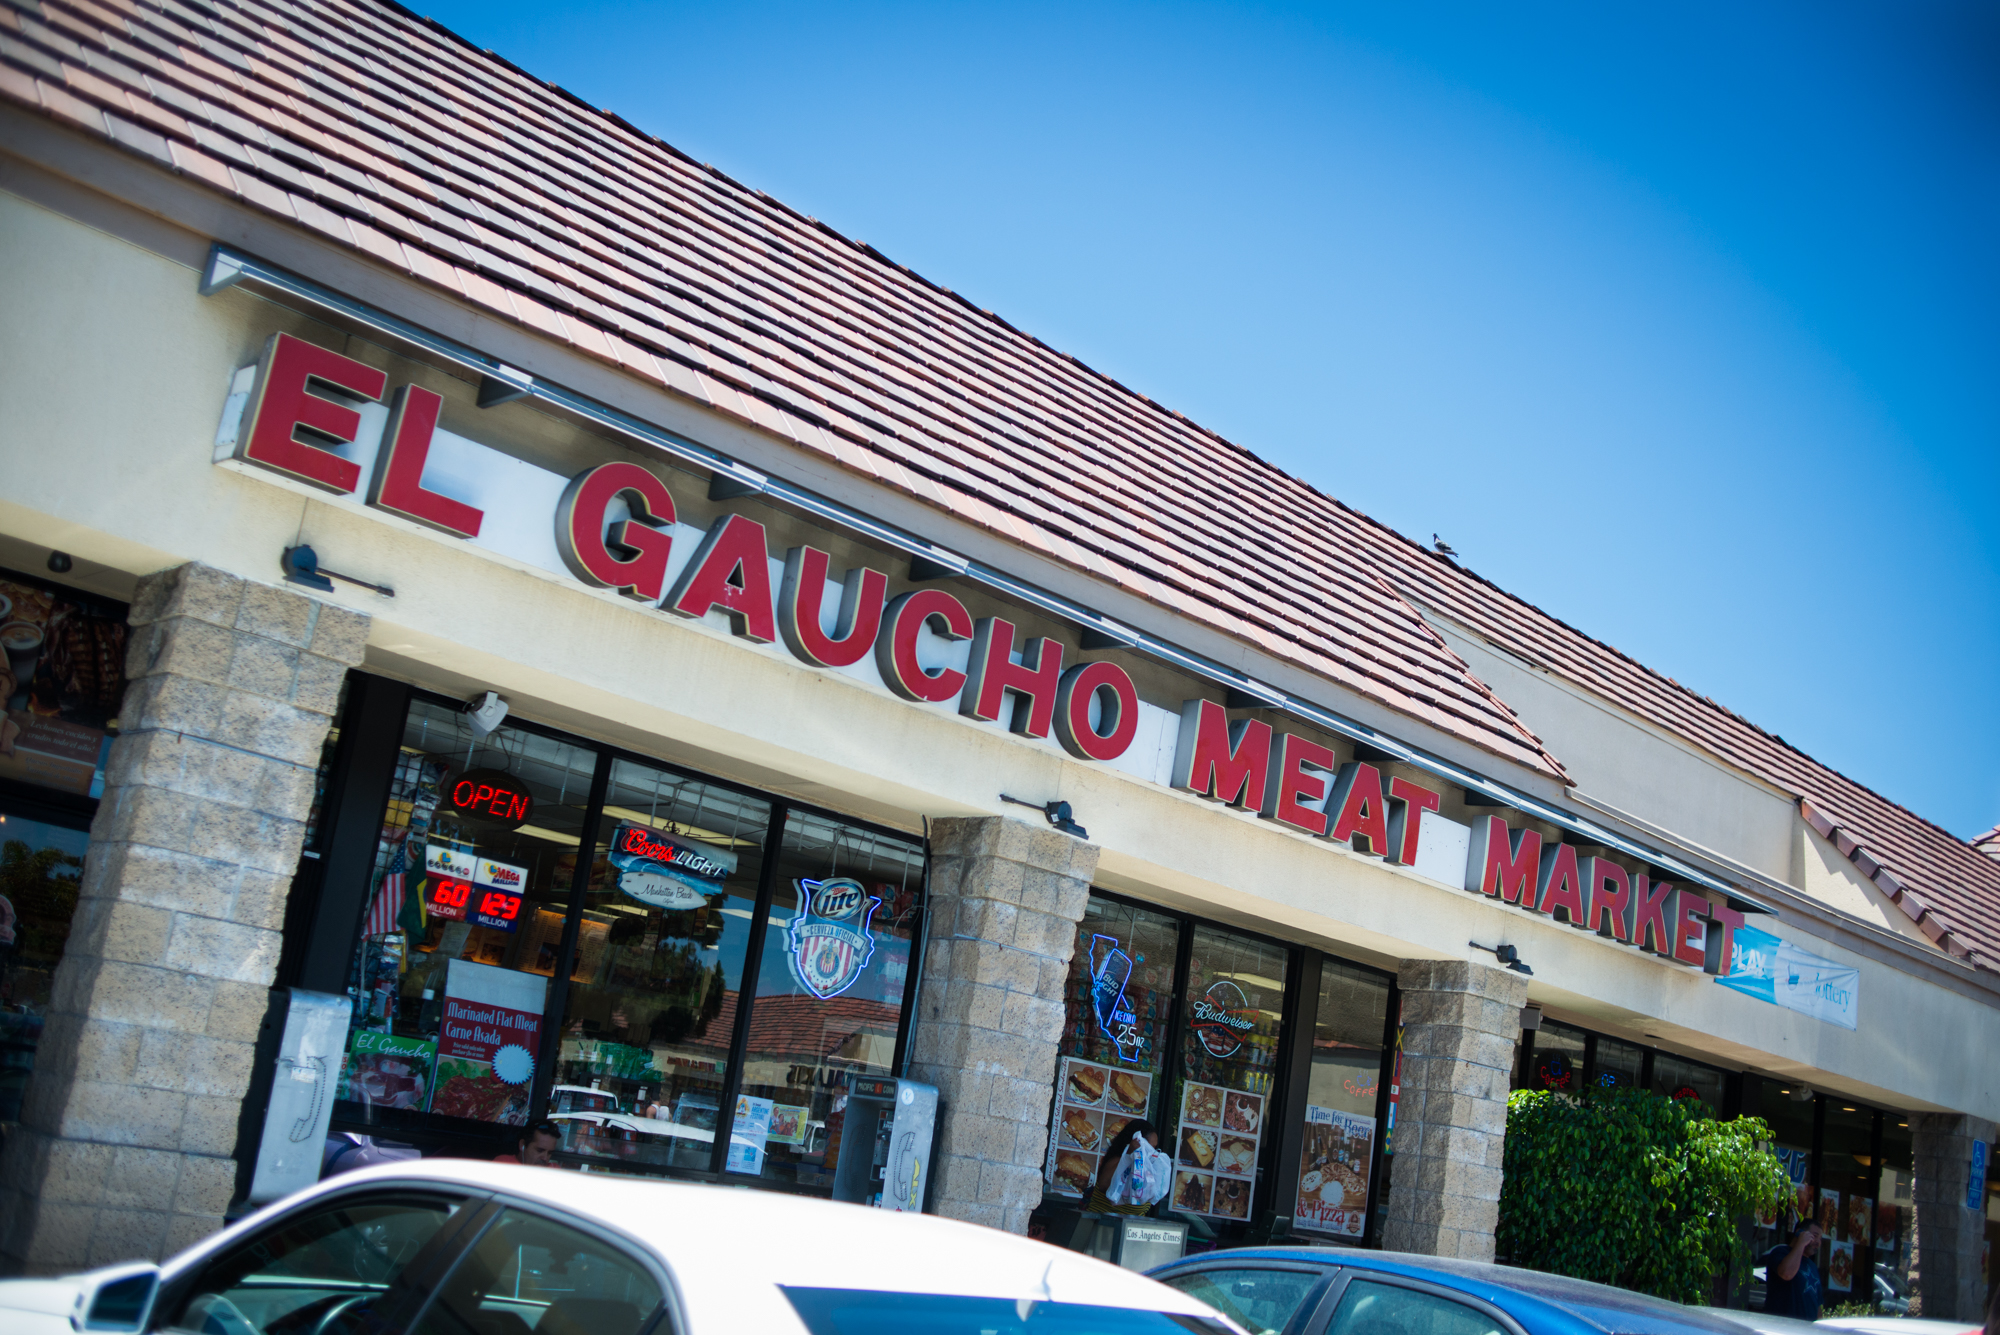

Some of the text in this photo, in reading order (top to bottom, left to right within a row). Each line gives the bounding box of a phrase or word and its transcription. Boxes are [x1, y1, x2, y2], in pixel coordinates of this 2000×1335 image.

[235, 331, 1746, 977] EL GAUCHO MEAT MARKET
[27, 732, 52, 743] crudos
[52, 738, 69, 747] todo
[69, 741, 78, 749] el
[30, 720, 65, 735] Lechones
[65, 729, 92, 741] cocidos
[453, 780, 529, 821] OPEN
[622, 828, 727, 877] Coors LIGHT
[495, 867, 520, 882] MEGA
[433, 880, 471, 908] 60
[640, 884, 694, 900] Manhattan Beach
[820, 892, 859, 917] Lite
[426, 902, 458, 917] MILLION
[479, 892, 522, 920] 123
[477, 915, 509, 929] MILLION
[810, 924, 856, 945] CERVEZA OFICIAL
[1102, 973, 1119, 990] BUD
[447, 1001, 538, 1033] Marinated Flat Meat
[1193, 1000, 1255, 1031] Budweiser
[445, 1020, 502, 1046] Carne Asada
[1116, 1023, 1137, 1046] 25
[356, 1033, 431, 1059] El Gaucho
[857, 1082, 895, 1095] PACIFIC COIN
[1310, 1106, 1331, 1122] Time
[1331, 1110, 1345, 1124] for
[1344, 1117, 1370, 1139] Beer
[1296, 1197, 1308, 1218] &
[1311, 1199, 1345, 1225] Pizza
[1127, 1228, 1181, 1243] Los Angeles Times
